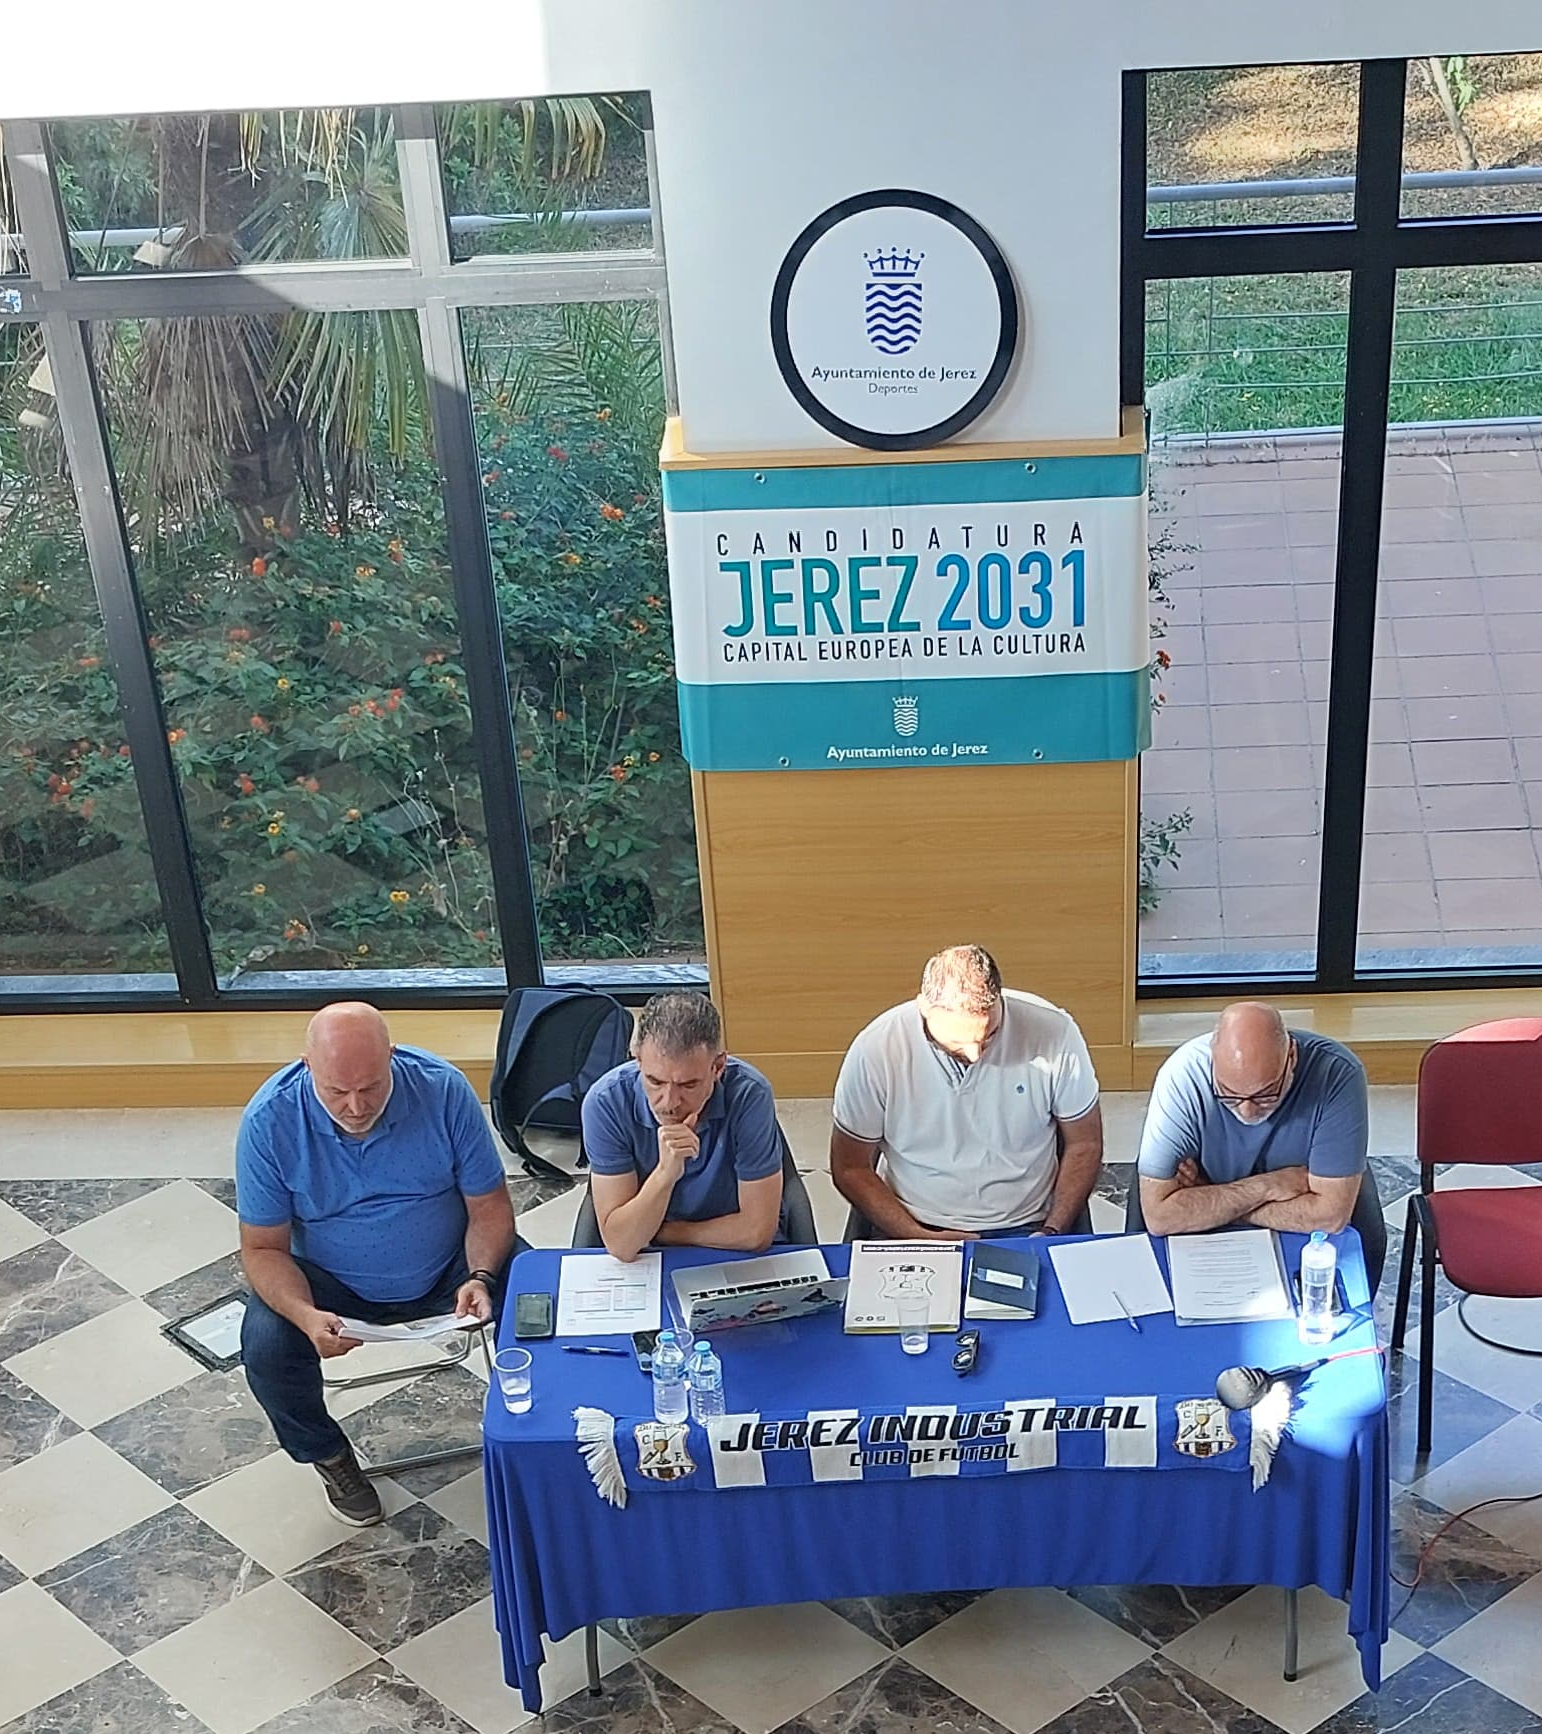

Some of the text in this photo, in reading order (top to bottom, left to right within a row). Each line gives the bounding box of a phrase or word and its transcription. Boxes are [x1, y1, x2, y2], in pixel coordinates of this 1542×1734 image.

[811, 366, 977, 382] Ayuntamiento de Jerez
[868, 383, 919, 396] Deportes
[717, 521, 1083, 556] CANDIDATURA
[719, 549, 1085, 637] JEREZ 2031
[723, 632, 1086, 662] CAPITAL EUROPEA DE LA CULTURA
[826, 742, 988, 762] Ayuntamiento de Jerez
[718, 1404, 1149, 1453] JEREZ INDUSTRIAL
[849, 1448, 905, 1468] CLUB
[907, 1447, 935, 1465] DE
